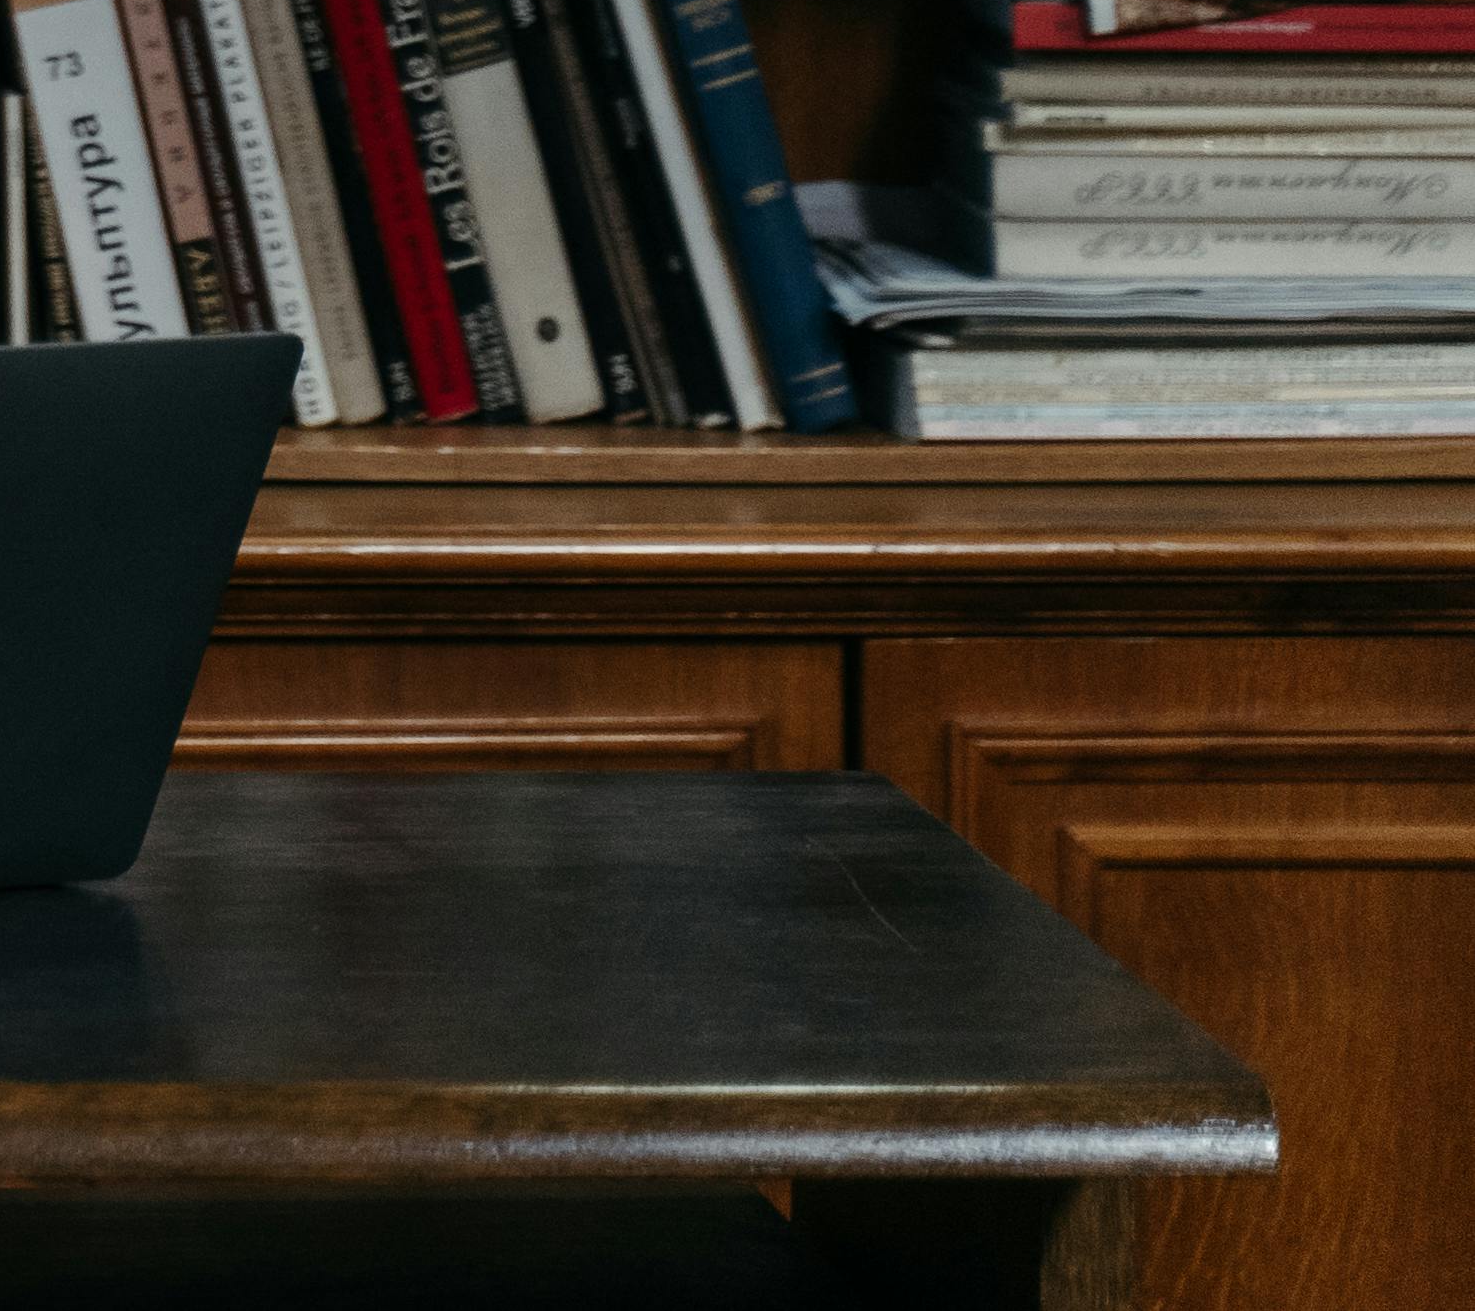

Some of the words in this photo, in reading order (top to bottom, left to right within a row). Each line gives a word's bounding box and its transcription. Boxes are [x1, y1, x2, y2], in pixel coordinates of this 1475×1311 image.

[42, 50, 85, 82] 73
[401, 57, 437, 102] de
[240, 113, 289, 270] LEIPZIGER
